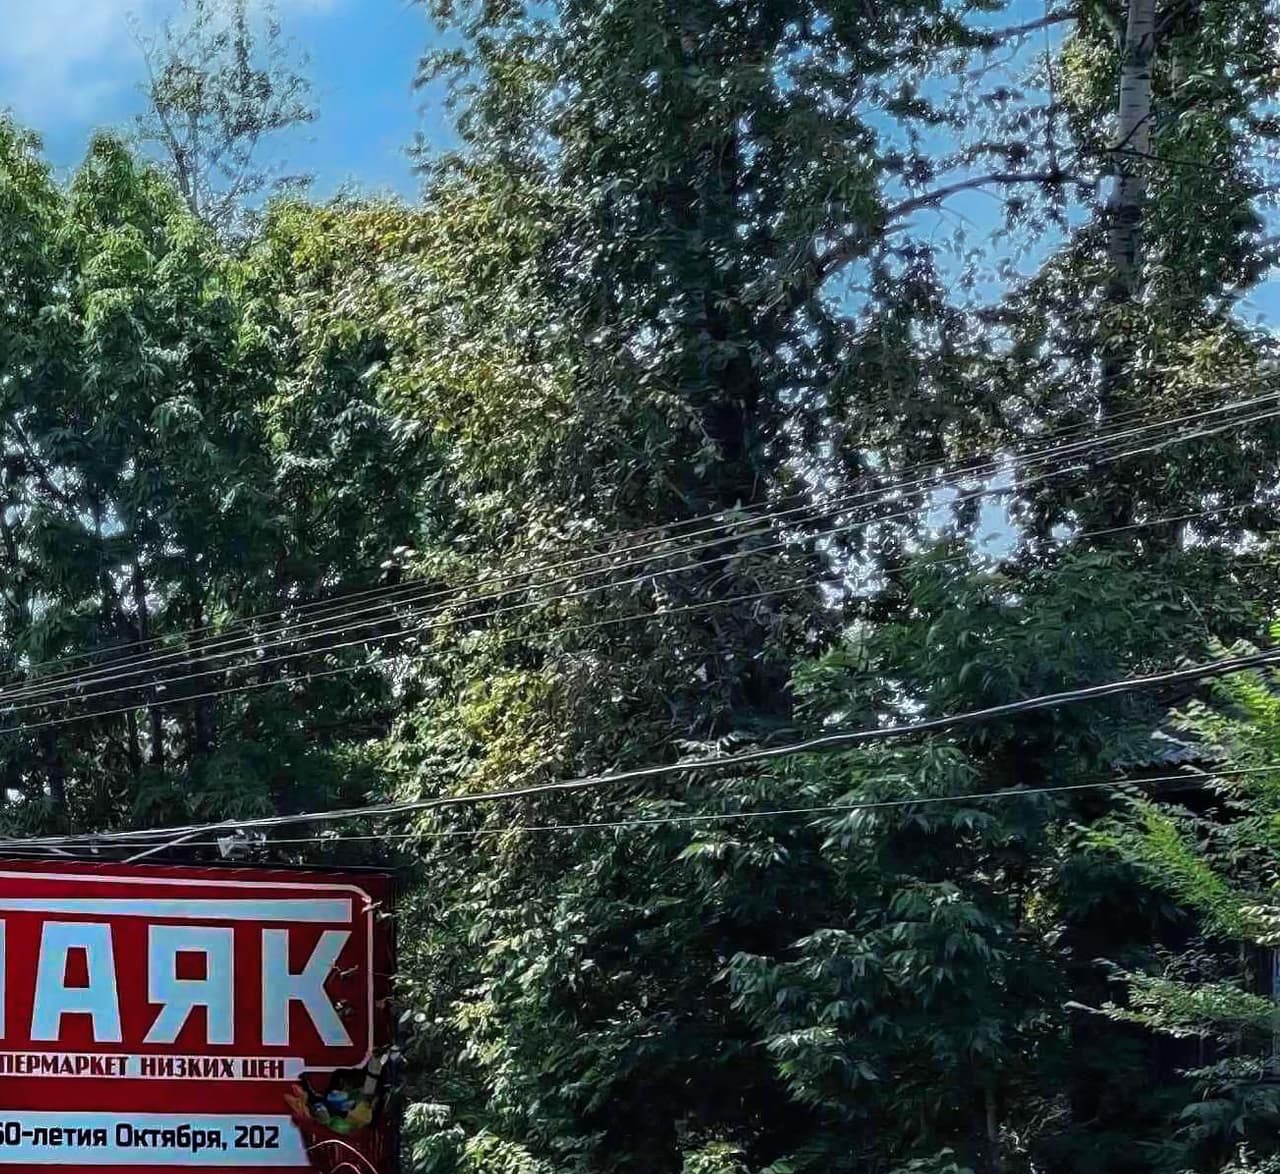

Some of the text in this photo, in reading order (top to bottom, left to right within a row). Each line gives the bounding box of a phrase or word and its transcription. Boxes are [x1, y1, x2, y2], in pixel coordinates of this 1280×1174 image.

[141, 1056, 235, 1078] НИЗКИХ
[241, 1059, 285, 1079] ЦЕН
[115, 1123, 228, 1152] Октября,
[234, 1124, 280, 1149] 202
